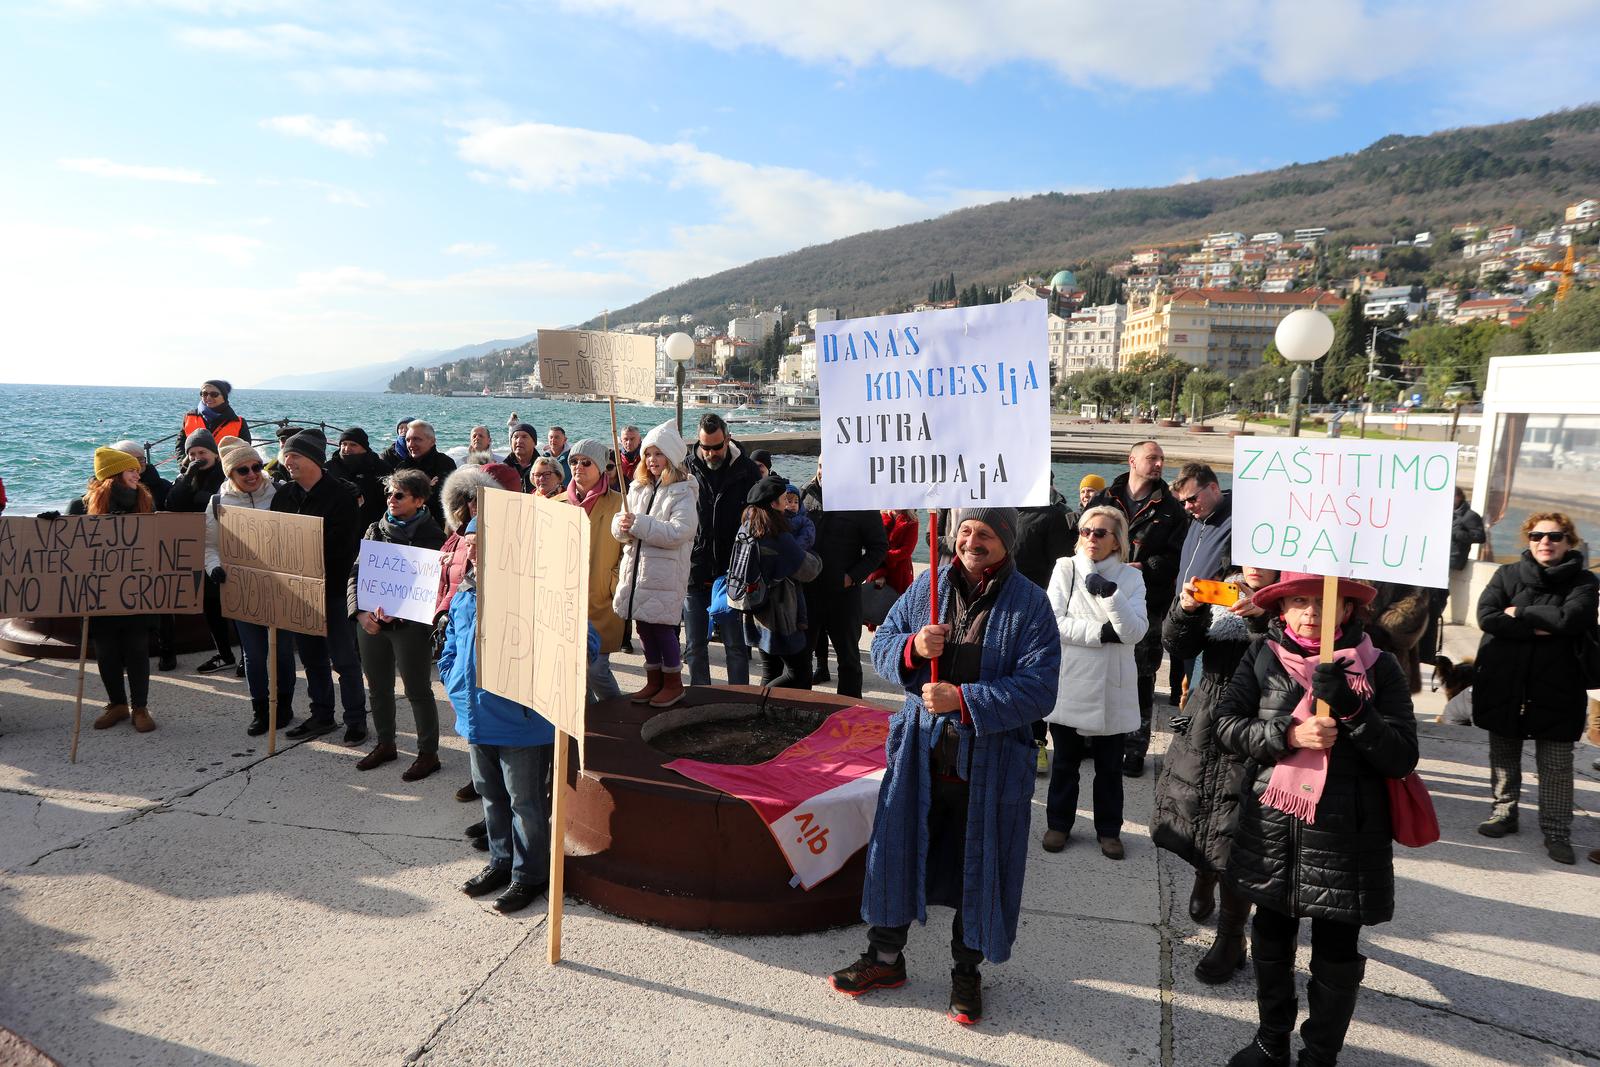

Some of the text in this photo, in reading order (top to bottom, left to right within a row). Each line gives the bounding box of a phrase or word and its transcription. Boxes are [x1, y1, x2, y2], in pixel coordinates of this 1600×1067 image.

[577, 332, 635, 362] JAVNO
[823, 326, 920, 363] DANAS
[543, 357, 570, 389] JE
[576, 359, 621, 393] NAŠE
[836, 411, 933, 444] SUTRA
[1238, 445, 1450, 491] ZAŠTITIMO
[1288, 490, 1392, 529] NAŠU
[0, 537, 198, 576] MATER HOTE, NE
[499, 497, 553, 579] NE
[410, 559, 441, 579] SVIMA
[0, 570, 203, 614] MO NAŠE GROTE!
[360, 578, 379, 594] NE
[379, 581, 408, 600] SAMO
